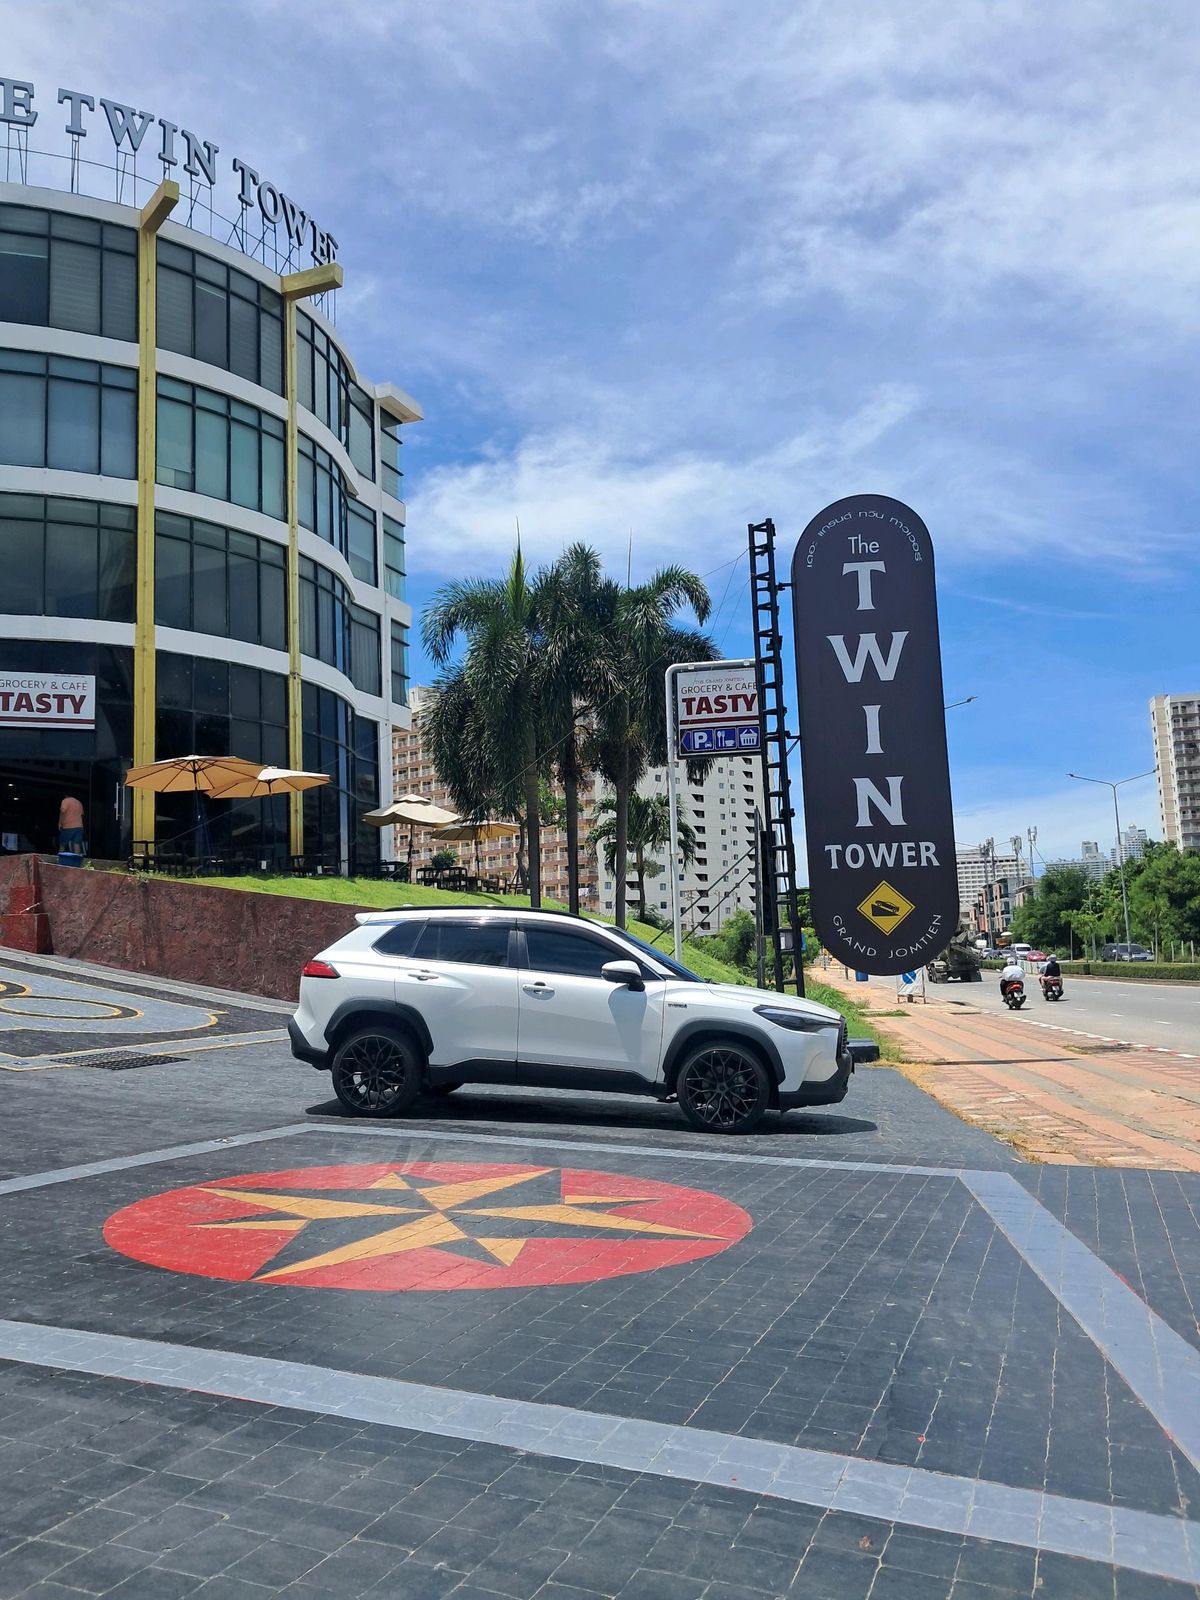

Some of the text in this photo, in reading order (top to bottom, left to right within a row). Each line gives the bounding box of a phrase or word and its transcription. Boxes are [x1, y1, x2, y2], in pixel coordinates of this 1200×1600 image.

[58, 88, 219, 185] TWIN
[806, 541, 818, 568] เดอะ
[847, 533, 880, 555] The
[0, 679, 47, 689] GROCERY
[50, 681, 58, 690] &
[681, 684, 723, 695] GROCERY
[725, 683, 733, 692] &
[0, 692, 87, 714] TASTY
[681, 693, 757, 716] TASTY
[694, 732, 708, 749] P
[824, 841, 940, 869] TOWER
[833, 914, 942, 959] GRAND JOMTIEN
